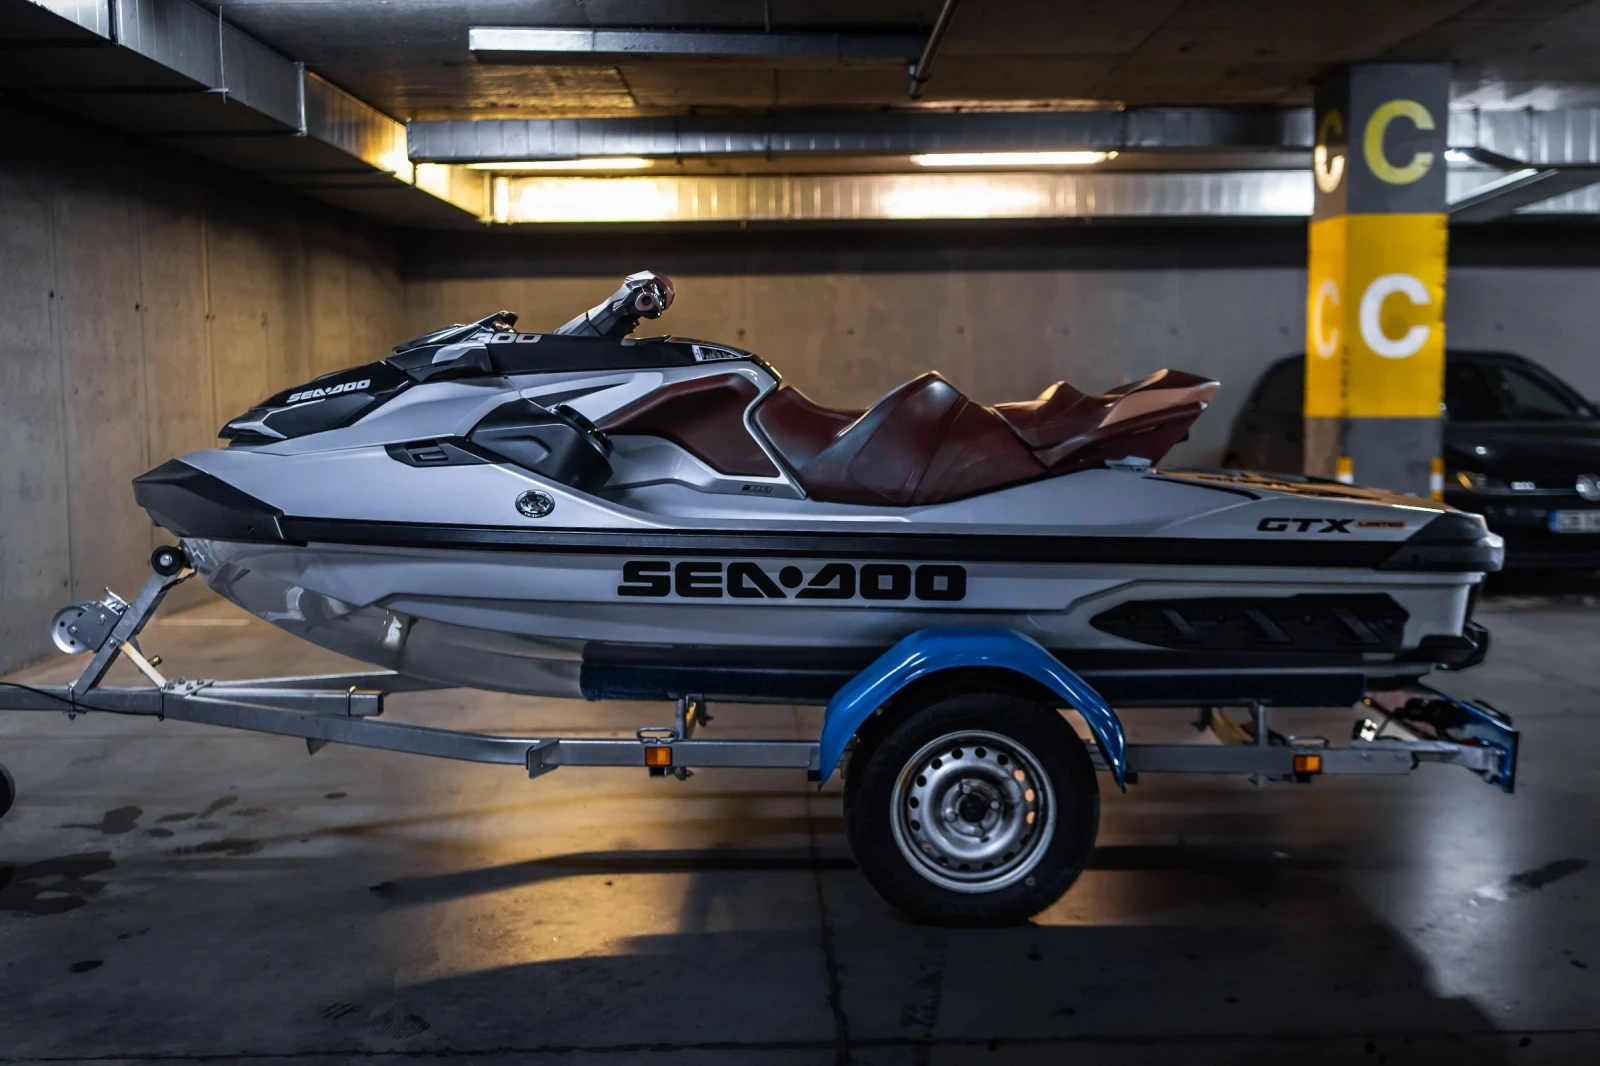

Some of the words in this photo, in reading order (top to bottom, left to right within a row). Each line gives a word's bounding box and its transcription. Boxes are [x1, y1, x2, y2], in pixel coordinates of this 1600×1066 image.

[1314, 109, 1344, 193] C
[1363, 99, 1435, 184] C
[469, 332, 542, 344] 300
[1313, 279, 1339, 360] C
[1359, 273, 1431, 359] C
[1257, 517, 1355, 533] GTX
